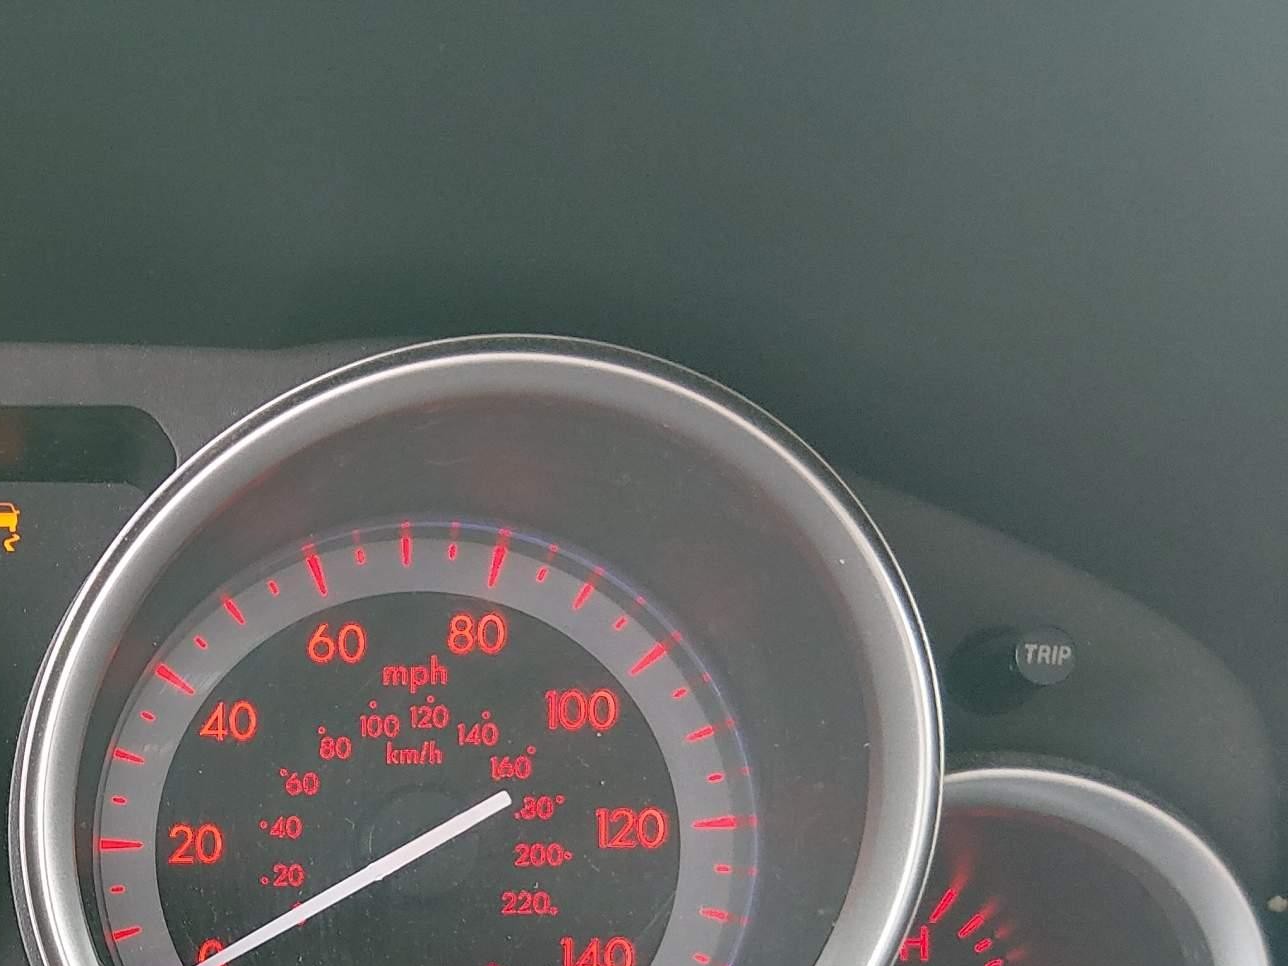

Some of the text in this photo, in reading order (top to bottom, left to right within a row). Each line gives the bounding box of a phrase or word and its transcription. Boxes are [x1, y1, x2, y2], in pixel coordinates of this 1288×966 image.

[307, 623, 366, 664] 60
[448, 613, 506, 654] 80
[1023, 643, 1072, 666] TRIP
[382, 655, 449, 694] mph
[200, 700, 258, 742] 40
[409, 704, 450, 729] 120
[545, 689, 617, 731] 100
[360, 714, 400, 738] 100
[457, 722, 500, 746] 140
[318, 736, 352, 761] 80
[385, 740, 444, 765] km/h
[489, 755, 532, 780] 160
[285, 771, 320, 796] 60
[269, 815, 304, 840] 40
[595, 807, 669, 850] 120
[168, 823, 224, 865] 20
[513, 843, 563, 868] 200
[272, 863, 305, 887] 20
[500, 890, 551, 915] 220
